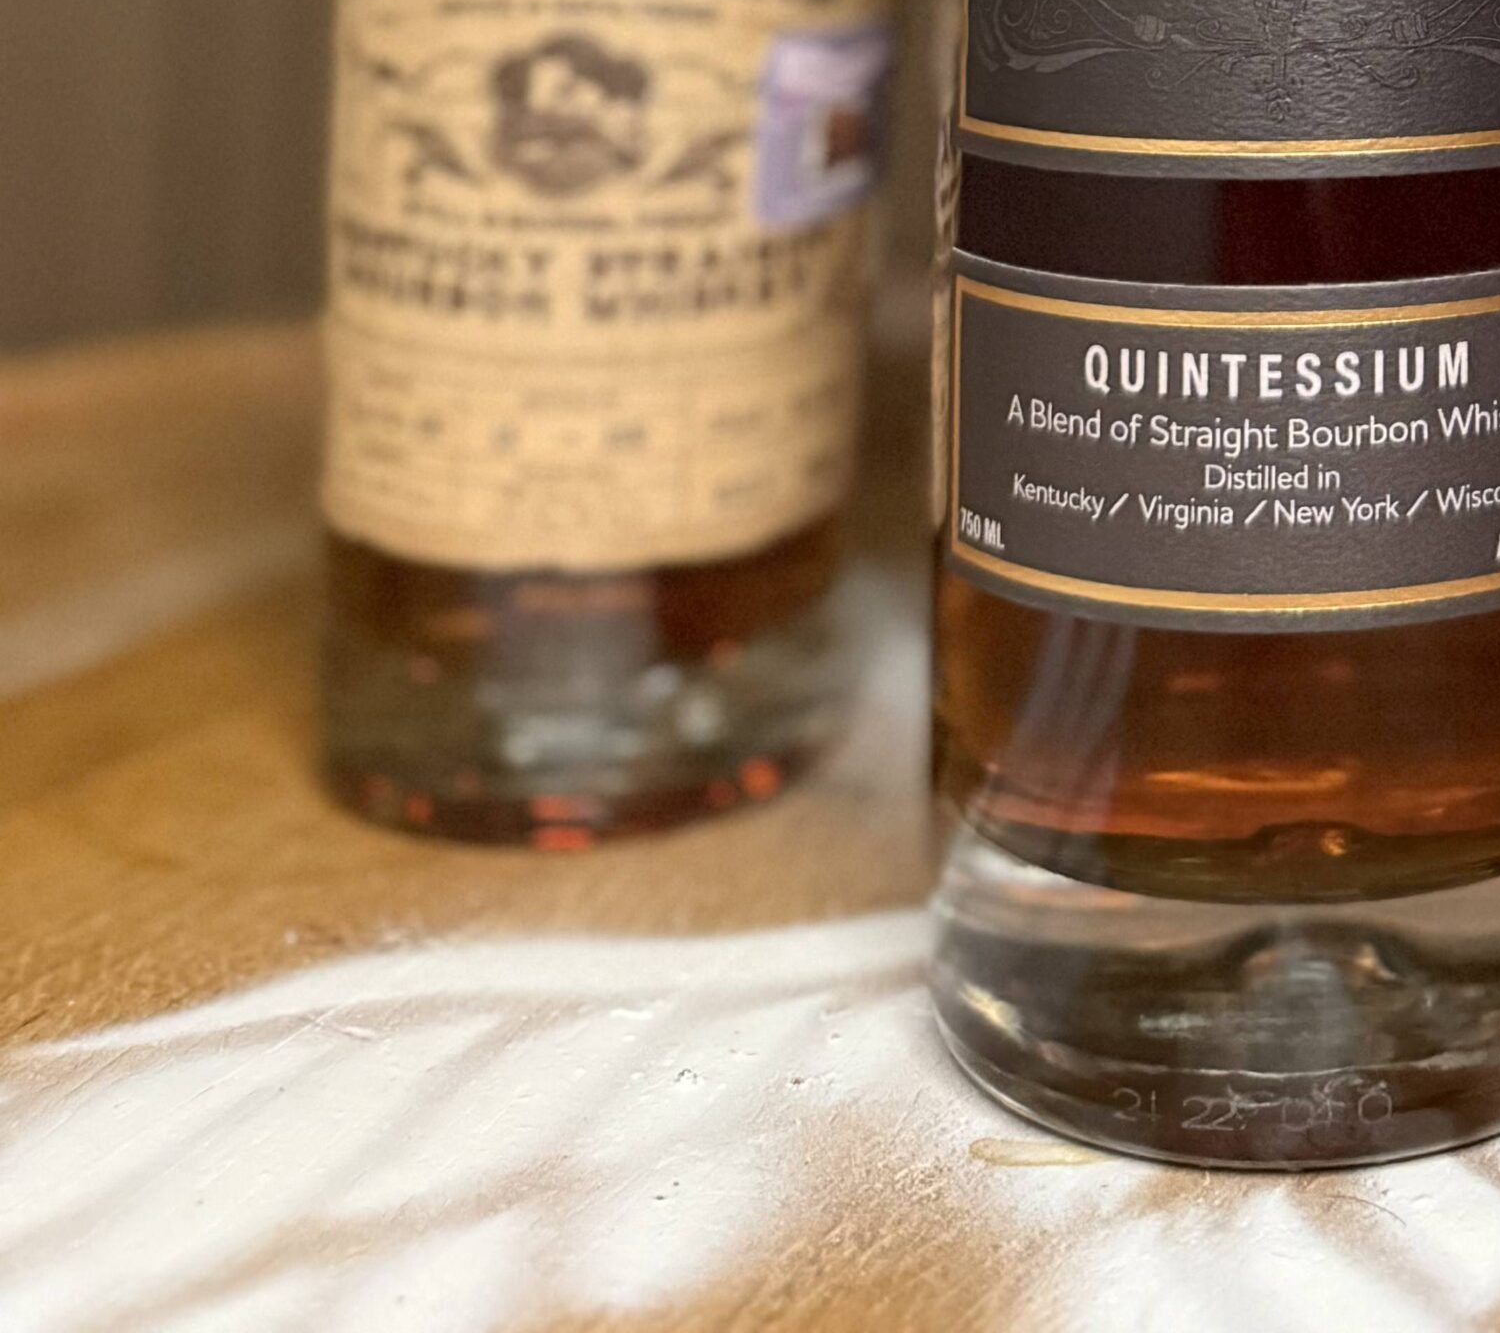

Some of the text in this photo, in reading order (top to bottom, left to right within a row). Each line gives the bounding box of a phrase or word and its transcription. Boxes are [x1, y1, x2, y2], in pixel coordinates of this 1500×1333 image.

[1083, 340, 1470, 399] QUINTESSIUM
[1007, 394, 1025, 425] A
[1030, 398, 1101, 440] Blend
[1110, 413, 1143, 448] of
[1150, 415, 1279, 459] Straight
[1288, 414, 1429, 451] Bourbon
[1012, 473, 1105, 520] Kentucky
[1139, 494, 1234, 530] Virginia
[1274, 499, 1335, 526] New
[1341, 494, 1400, 522] York
[1204, 463, 1341, 490] Distilled in
